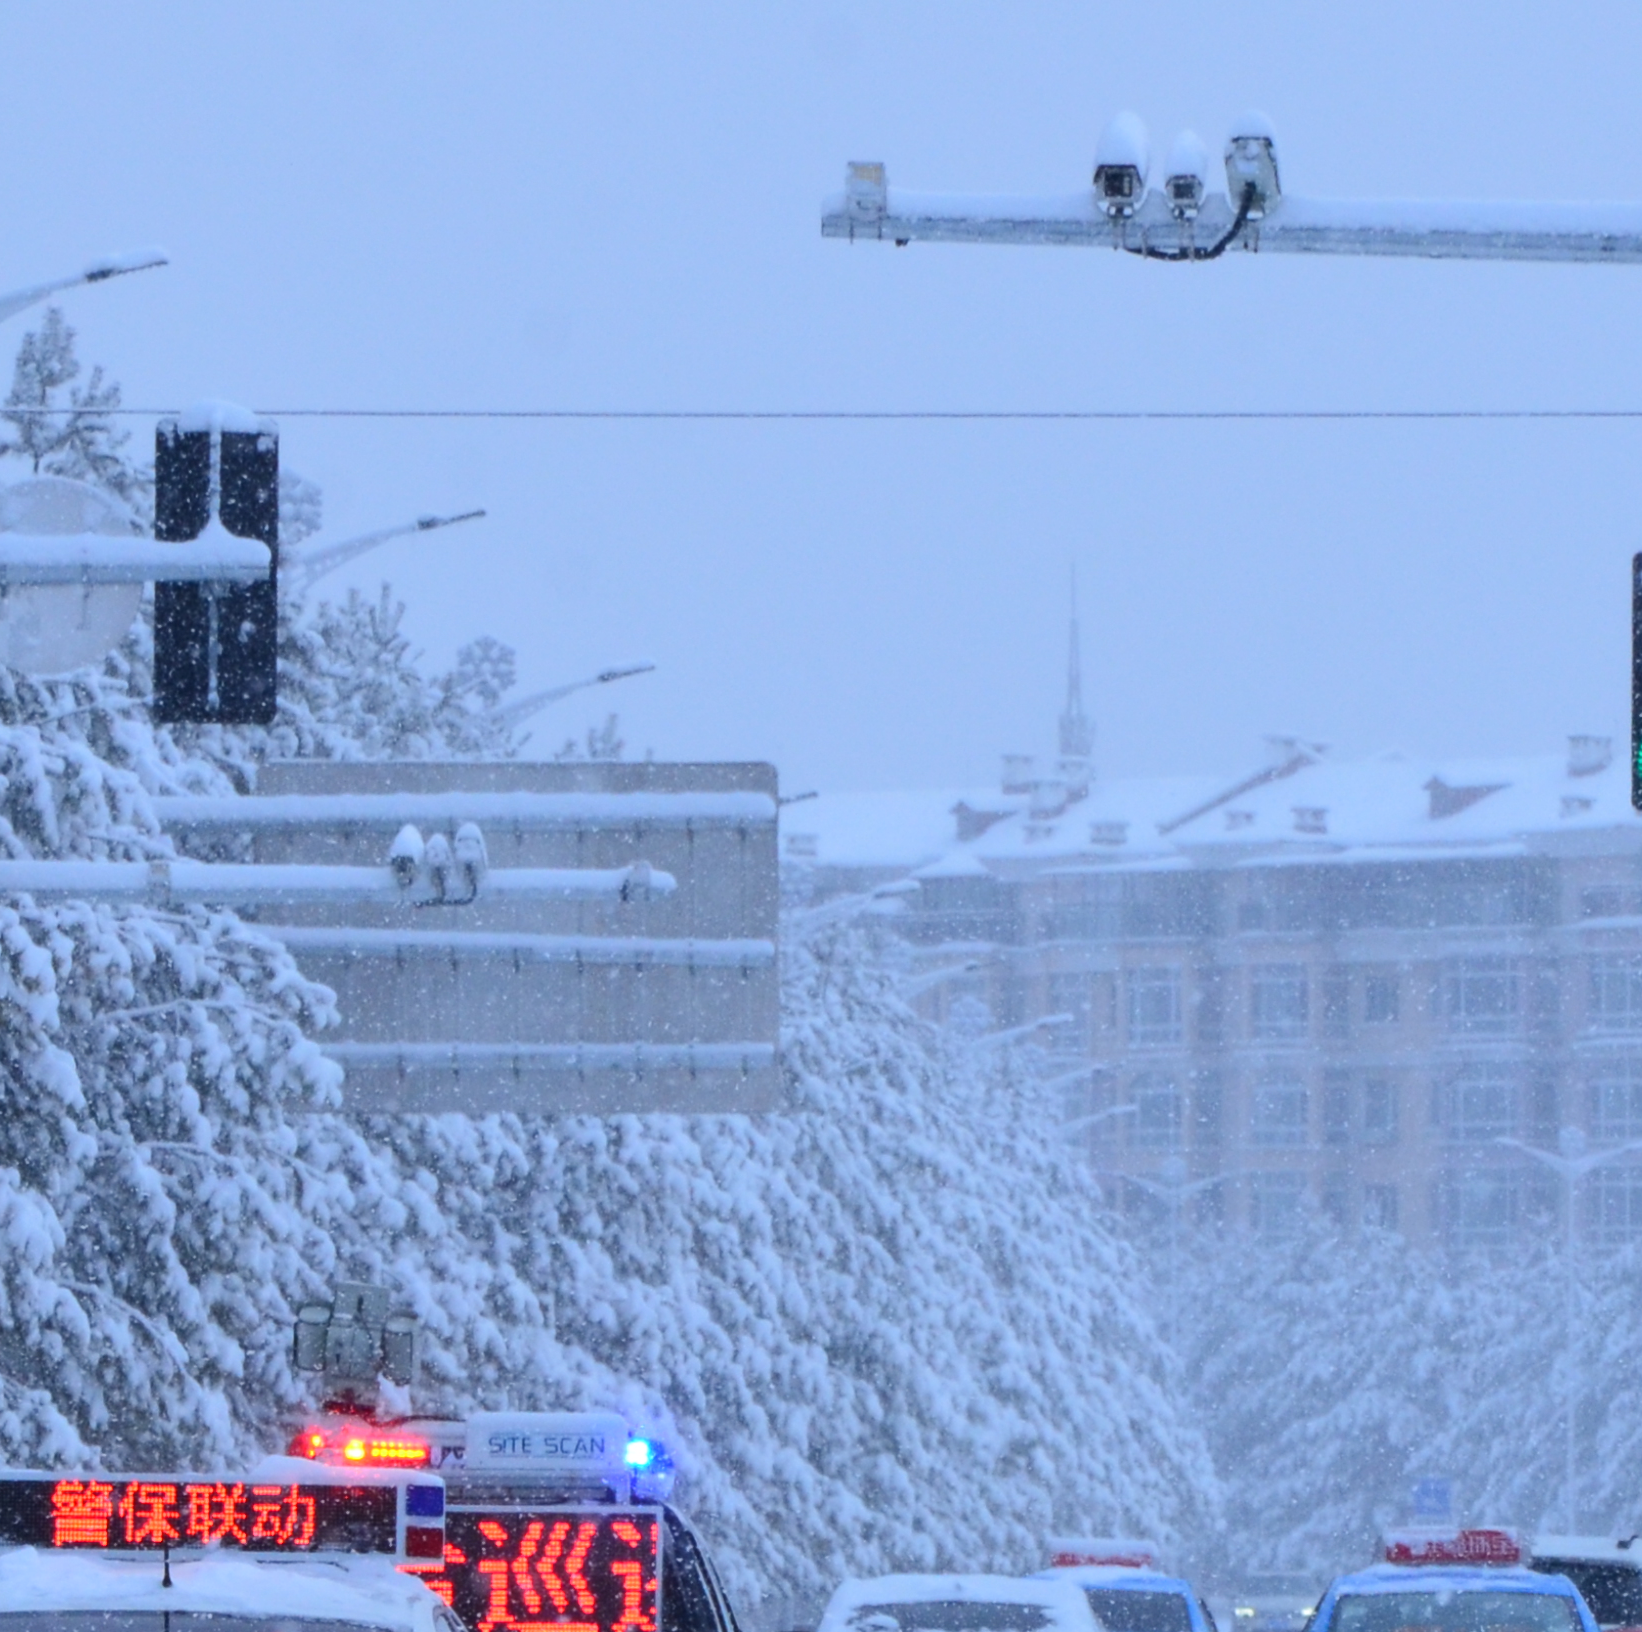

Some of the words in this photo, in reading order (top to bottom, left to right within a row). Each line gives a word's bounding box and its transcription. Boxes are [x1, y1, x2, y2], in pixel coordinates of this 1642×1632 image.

[488, 1436, 531, 1455] SITE
[544, 1436, 605, 1455] SCAN
[52, 1478, 316, 1547] 警保联动
